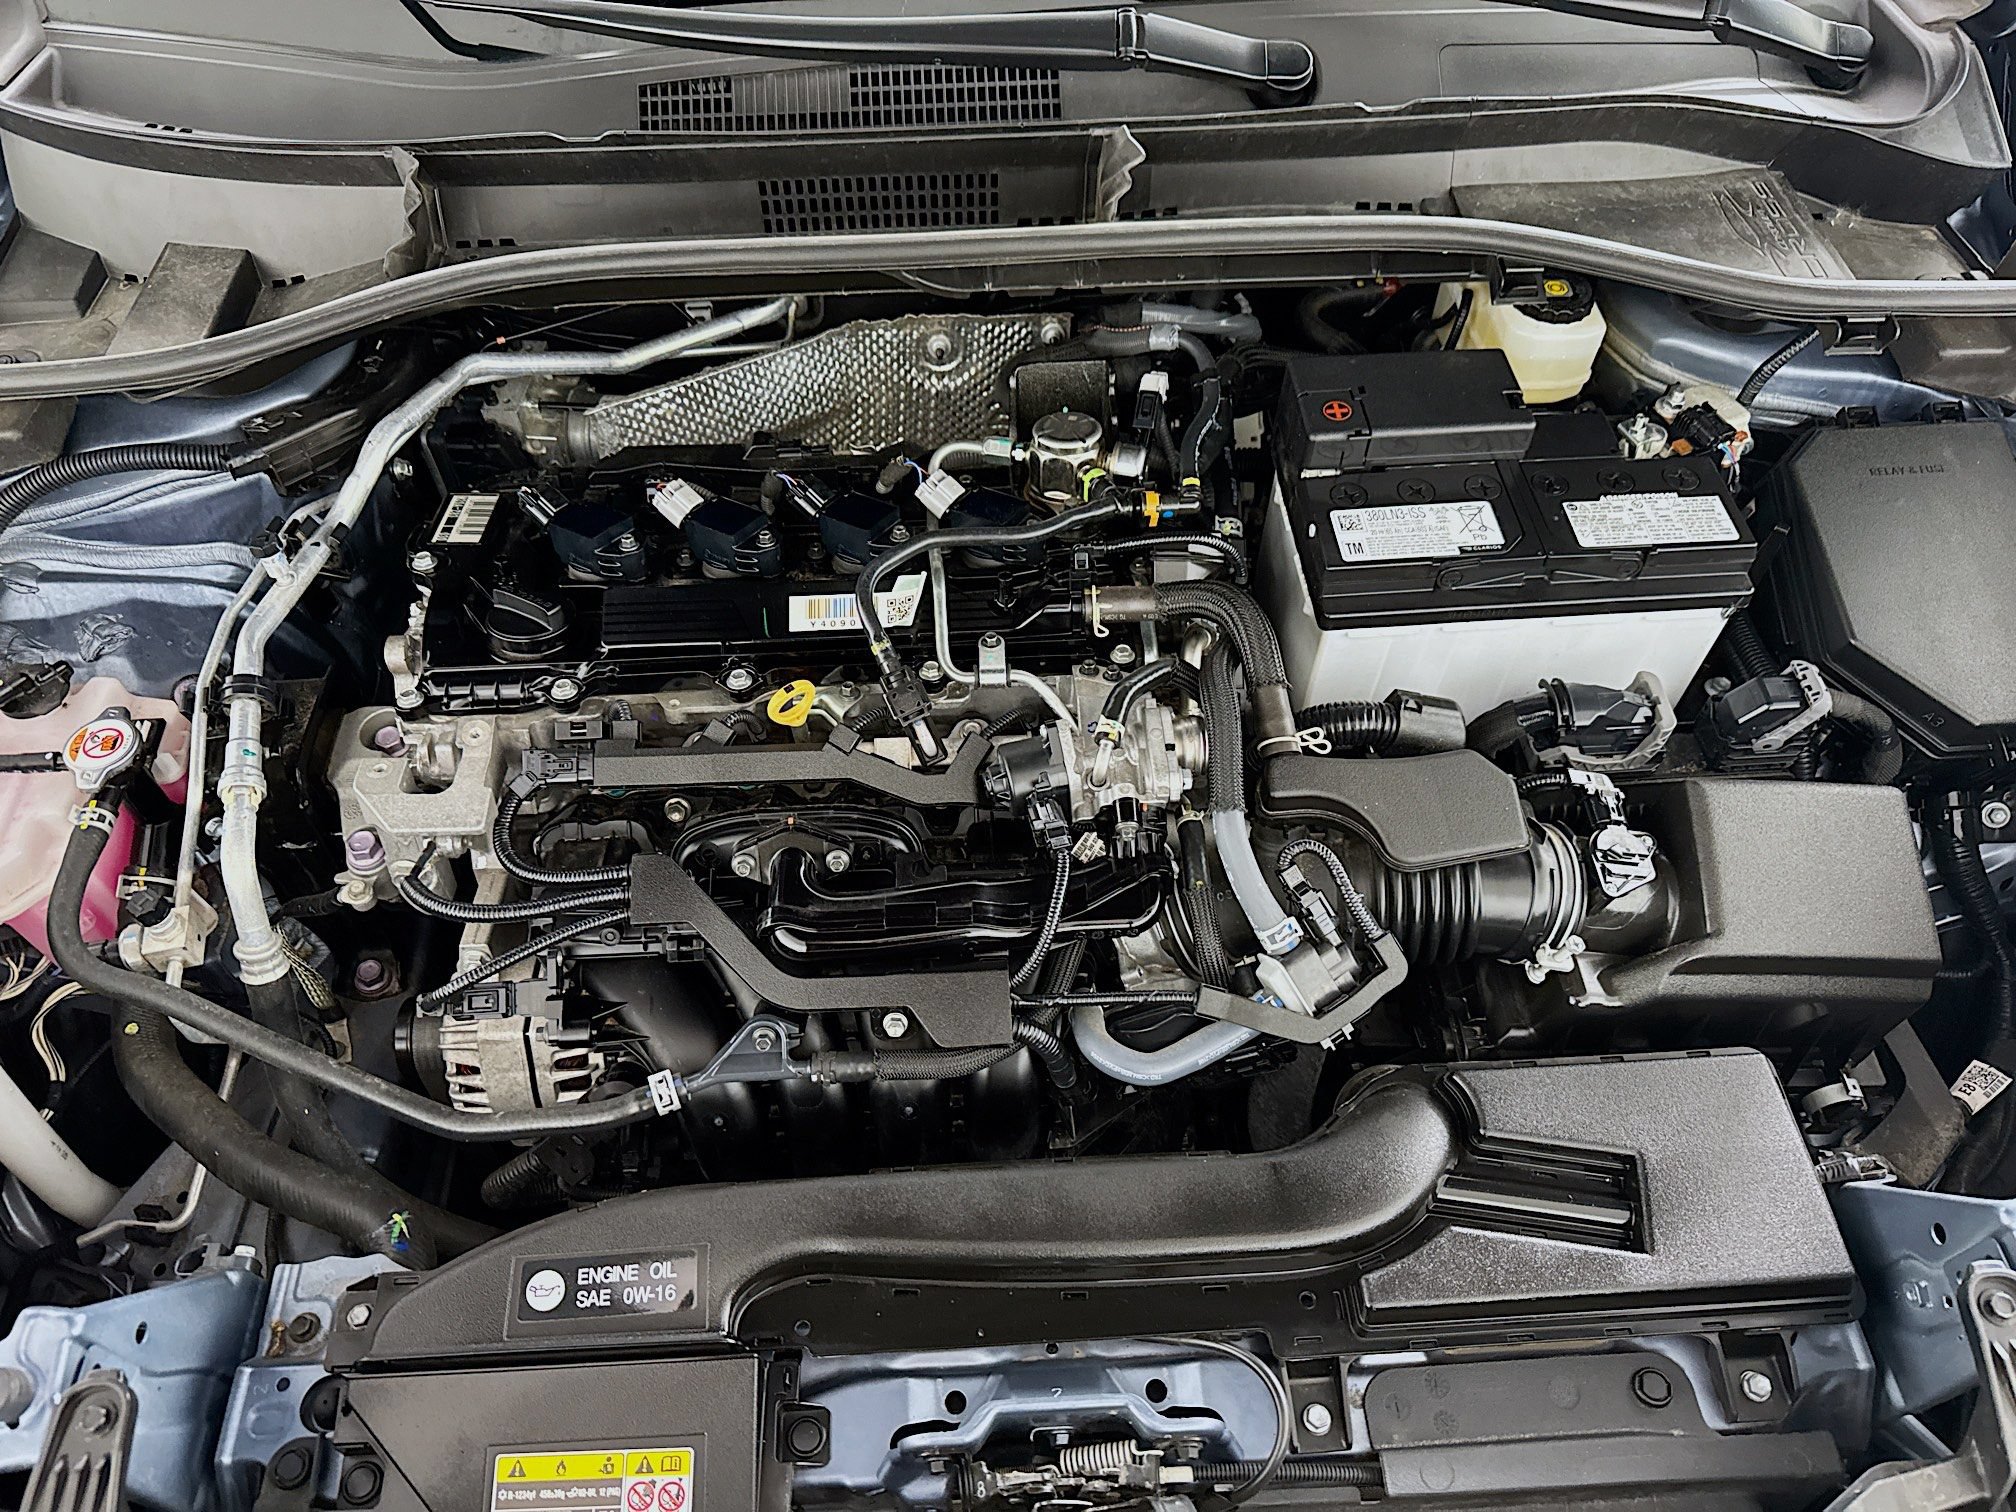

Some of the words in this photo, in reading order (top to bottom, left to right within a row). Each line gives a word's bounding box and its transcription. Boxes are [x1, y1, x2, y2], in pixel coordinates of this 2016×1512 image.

[1751, 181, 1829, 279] CROSS
[1364, 506, 1427, 522] 380LN3-ISS
[1473, 533, 1488, 541] Pb
[1345, 542, 1364, 556] TM
[1957, 1082, 1977, 1097] E8
[577, 1264, 639, 1285] ENGINE
[649, 1260, 677, 1280] OIL
[575, 1289, 611, 1309] SAE
[622, 1284, 677, 1305] 0W-16
[976, 1480, 987, 1498] 8
